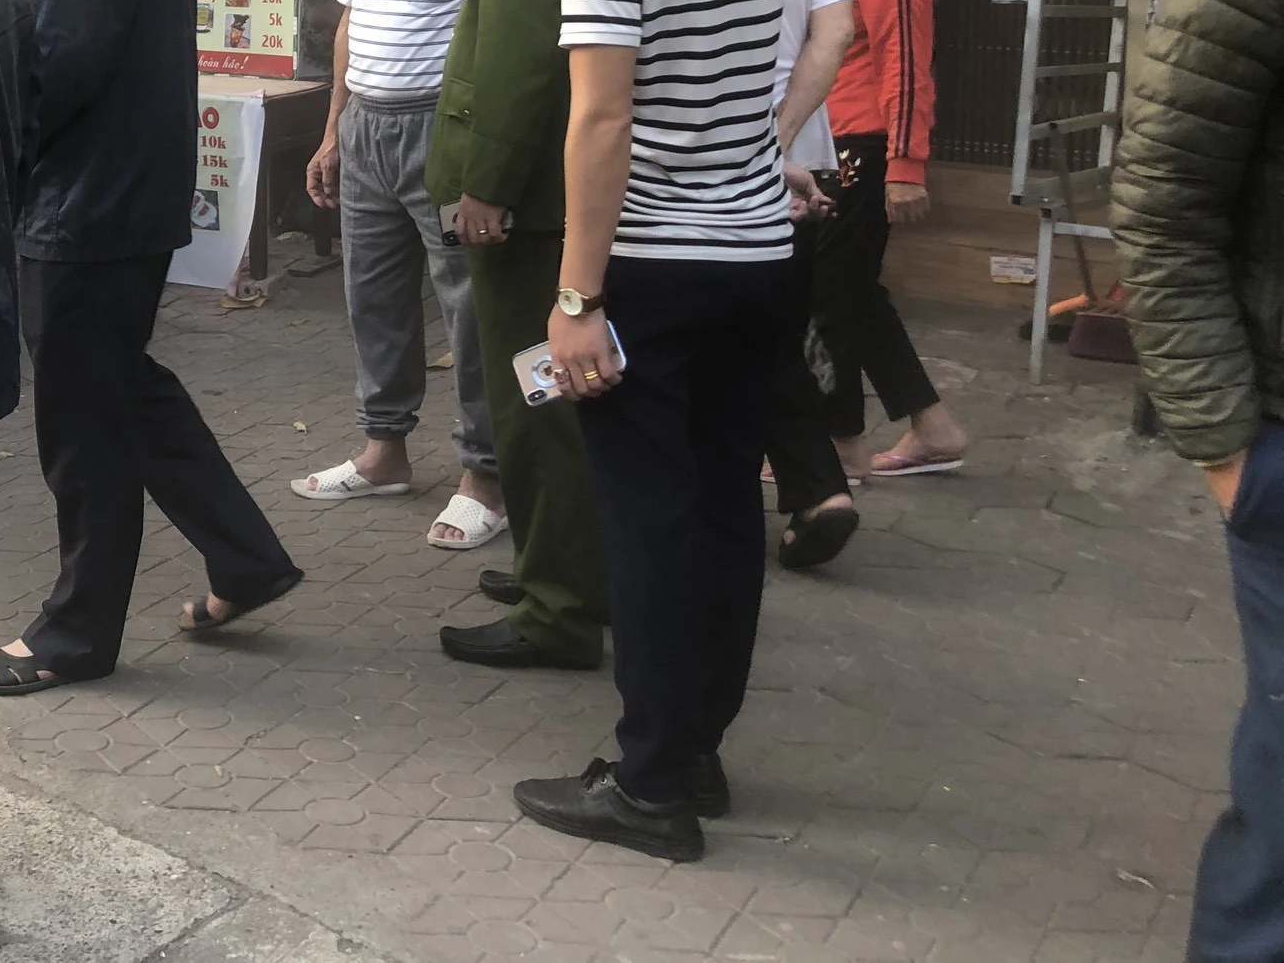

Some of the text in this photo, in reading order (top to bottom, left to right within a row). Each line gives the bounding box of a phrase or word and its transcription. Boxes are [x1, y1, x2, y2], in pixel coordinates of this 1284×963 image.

[269, 12, 282, 27] 5k
[261, 33, 283, 49] 20k
[200, 135, 227, 150] 10k
[201, 154, 228, 168] 15k
[210, 174, 230, 187] 5k
